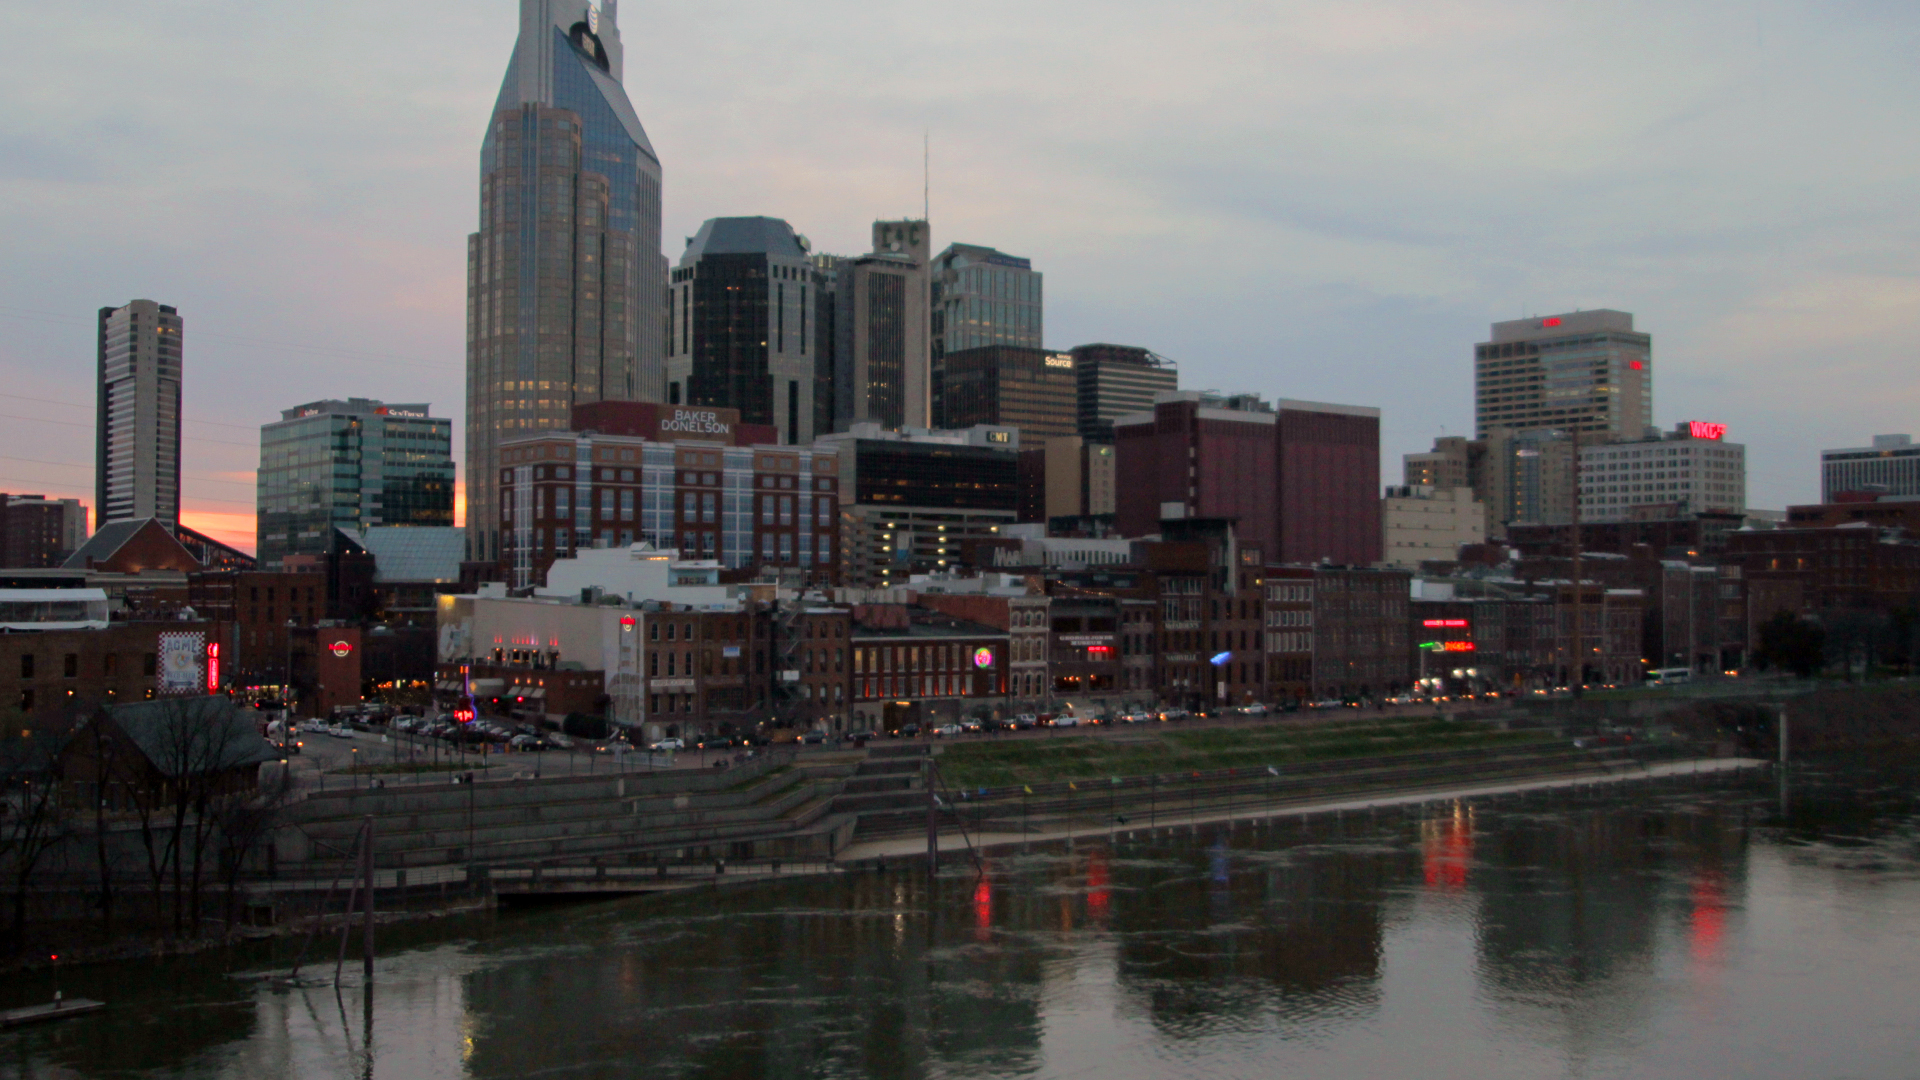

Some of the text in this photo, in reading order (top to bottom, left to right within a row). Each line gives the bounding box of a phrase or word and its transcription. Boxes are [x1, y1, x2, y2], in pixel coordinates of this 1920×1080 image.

[1045, 356, 1072, 368] Source
[675, 409, 716, 423] BAKER
[661, 419, 729, 434] DONELSON
[989, 431, 1008, 442] CMT
[165, 638, 198, 653] ACME
